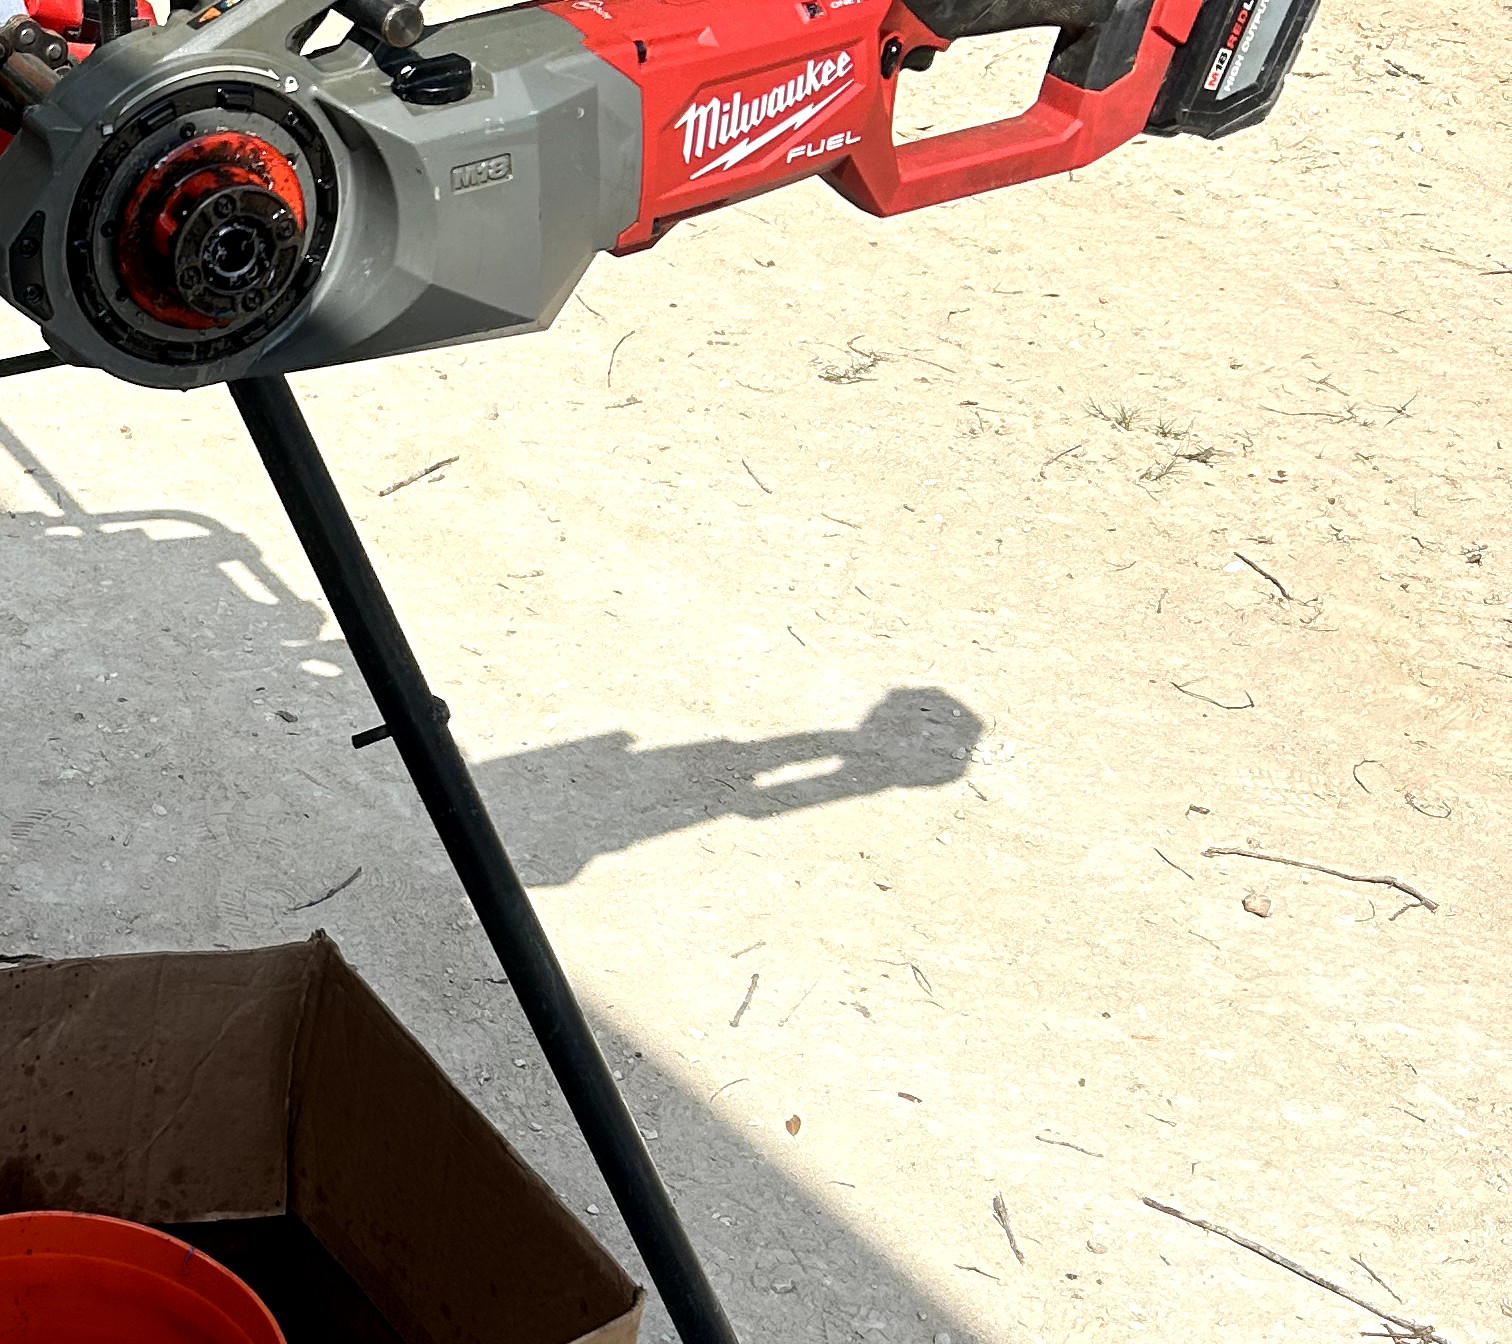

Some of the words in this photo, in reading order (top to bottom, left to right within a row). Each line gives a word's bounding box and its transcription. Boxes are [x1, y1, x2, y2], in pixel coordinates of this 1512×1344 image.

[1206, 51, 1229, 89] M18
[1223, 55, 1245, 92] HIGH
[674, 51, 854, 164] Milwaukee
[786, 130, 861, 163] FUEL
[452, 156, 511, 190] M18
